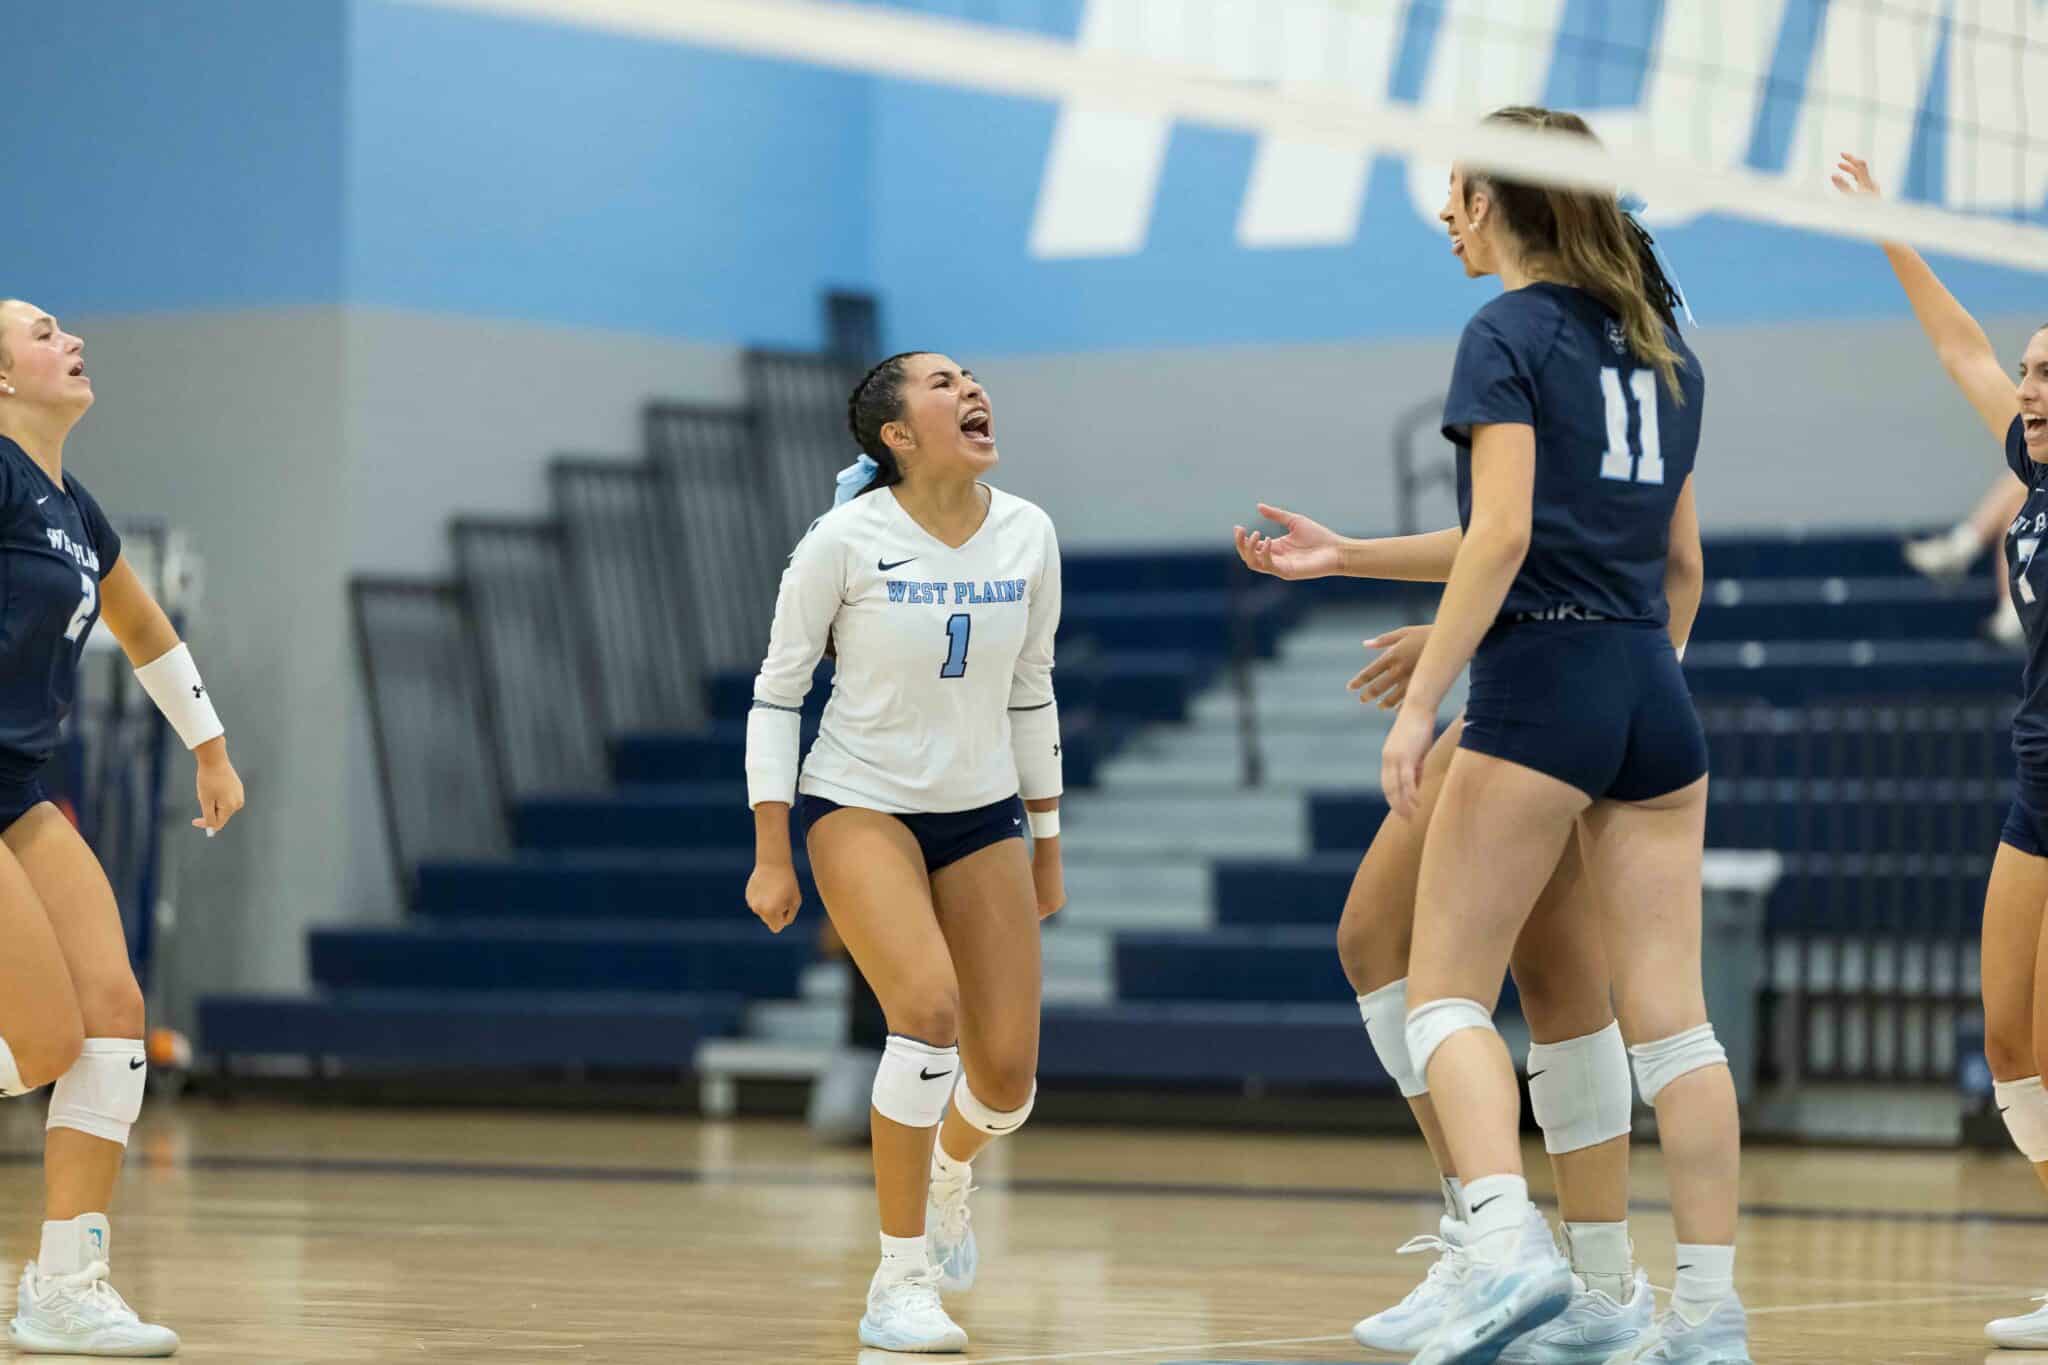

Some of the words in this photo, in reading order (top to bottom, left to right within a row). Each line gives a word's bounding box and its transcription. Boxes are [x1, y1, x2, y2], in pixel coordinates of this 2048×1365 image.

[1600, 366, 1664, 485] 11
[886, 580, 948, 605] WEST
[953, 578, 1026, 604] PLAINS
[2017, 538, 2041, 604] 7
[64, 571, 97, 643] 2
[940, 613, 971, 679] 1
